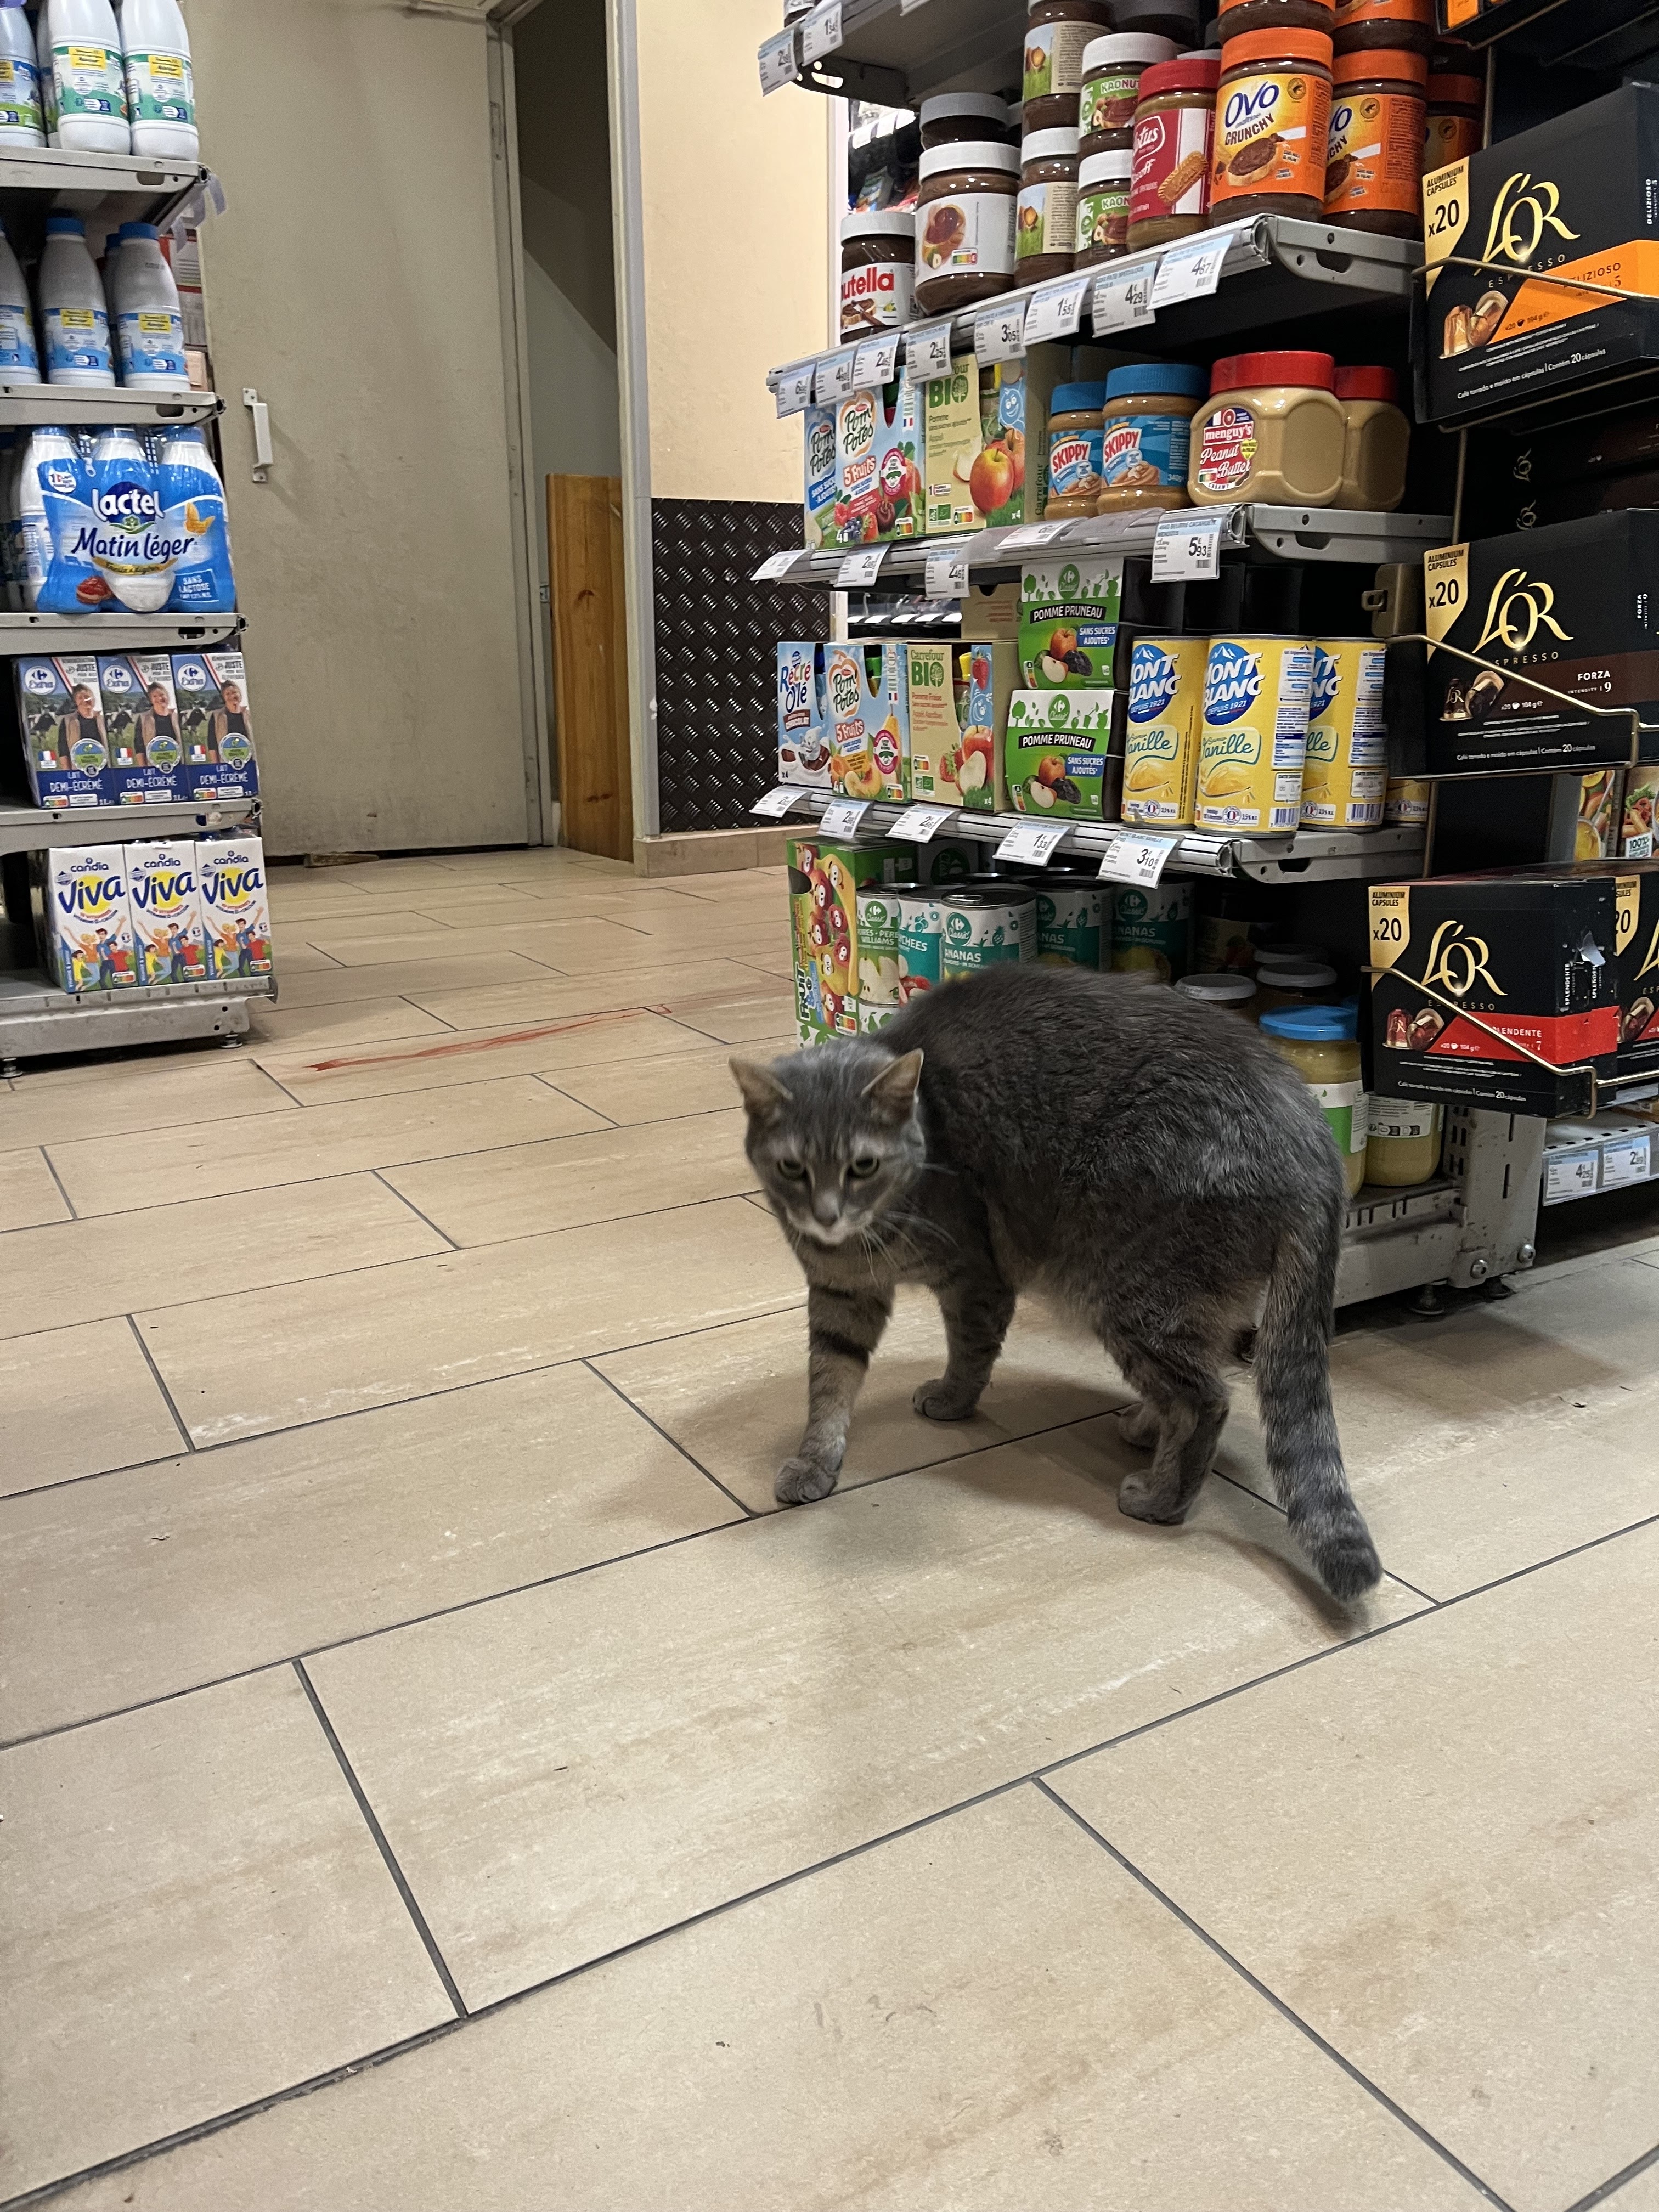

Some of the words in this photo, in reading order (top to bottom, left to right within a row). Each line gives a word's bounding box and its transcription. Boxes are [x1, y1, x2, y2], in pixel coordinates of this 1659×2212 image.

[1226, 81, 1279, 128] OVO
[1225, 113, 1274, 146] CRUNCHY
[1426, 165, 1464, 188] ALUMINIUM
[1426, 177, 1457, 196] CAPSULES
[1103, 196, 1130, 209] KAON
[1428, 199, 1460, 237] x20
[1571, 353, 1581, 363] 20
[1205, 424, 1252, 441] menguy's
[843, 427, 873, 455] Potes
[1104, 431, 1139, 462] SKIPPY
[1052, 444, 1088, 472] SKIPPY
[1200, 444, 1239, 465] Peanut
[844, 469, 851, 484] 5
[1217, 460, 1251, 478] Butter
[1035, 464, 1043, 515] Carrefour
[92, 488, 165, 522] lactel
[71, 527, 139, 558] Matin
[144, 534, 195, 563] léger
[1427, 549, 1464, 563] ALUMINIUM
[1427, 558, 1458, 571] CAPSULES
[1429, 579, 1459, 608] x20
[1033, 607, 1065, 621] POMME
[1065, 606, 1103, 619] PRUNEAU
[1471, 568, 1575, 654] L'OR
[1080, 627, 1093, 636] SANS
[1094, 626, 1116, 635] SUCRES
[911, 649, 944, 661] Carrefour
[1489, 651, 1559, 667] SPRESSO
[780, 660, 811, 693] Récré
[911, 661, 944, 687] BIO
[1131, 653, 1180, 684] ONT
[1578, 670, 1611, 681] FORZA
[833, 673, 856, 692] Pom
[1128, 675, 1182, 706] LANC
[1604, 681, 1612, 693] 9
[786, 682, 808, 713] Olé
[833, 690, 860, 713] Potes
[1149, 699, 1165, 708] 1921
[1229, 699, 1247, 710] 1921
[1023, 734, 1053, 747] POMME
[1053, 733, 1092, 749] PRUNEAU
[1562, 744, 1572, 753] 20
[1068, 757, 1082, 765] SANS
[1082, 756, 1103, 766] SUCRES
[49, 779, 104, 792] DEMI-ÉCRÉMÉ
[126, 775, 177, 789] DEMI-ÉCRÉMÉ
[199, 772, 249, 785] DEMI-ÉCRÉMÉ
[984, 797, 992, 805] x4
[70, 862, 109, 873] candia
[144, 858, 181, 868] candia
[213, 855, 249, 865] candia
[1373, 917, 1402, 941] x20
[1616, 909, 1631, 934] 20
[1042, 933, 1064, 944] NAS
[1116, 926, 1156, 938] NANAS
[861, 936, 895, 945] WILLIAMS
[899, 934, 928, 952] CHEES
[945, 948, 981, 963] ANANAS
[1420, 919, 1508, 996] L'OR
[1428, 999, 1496, 1011] ESRESSO
[1491, 1026, 1542, 1038] PLENDENTE
